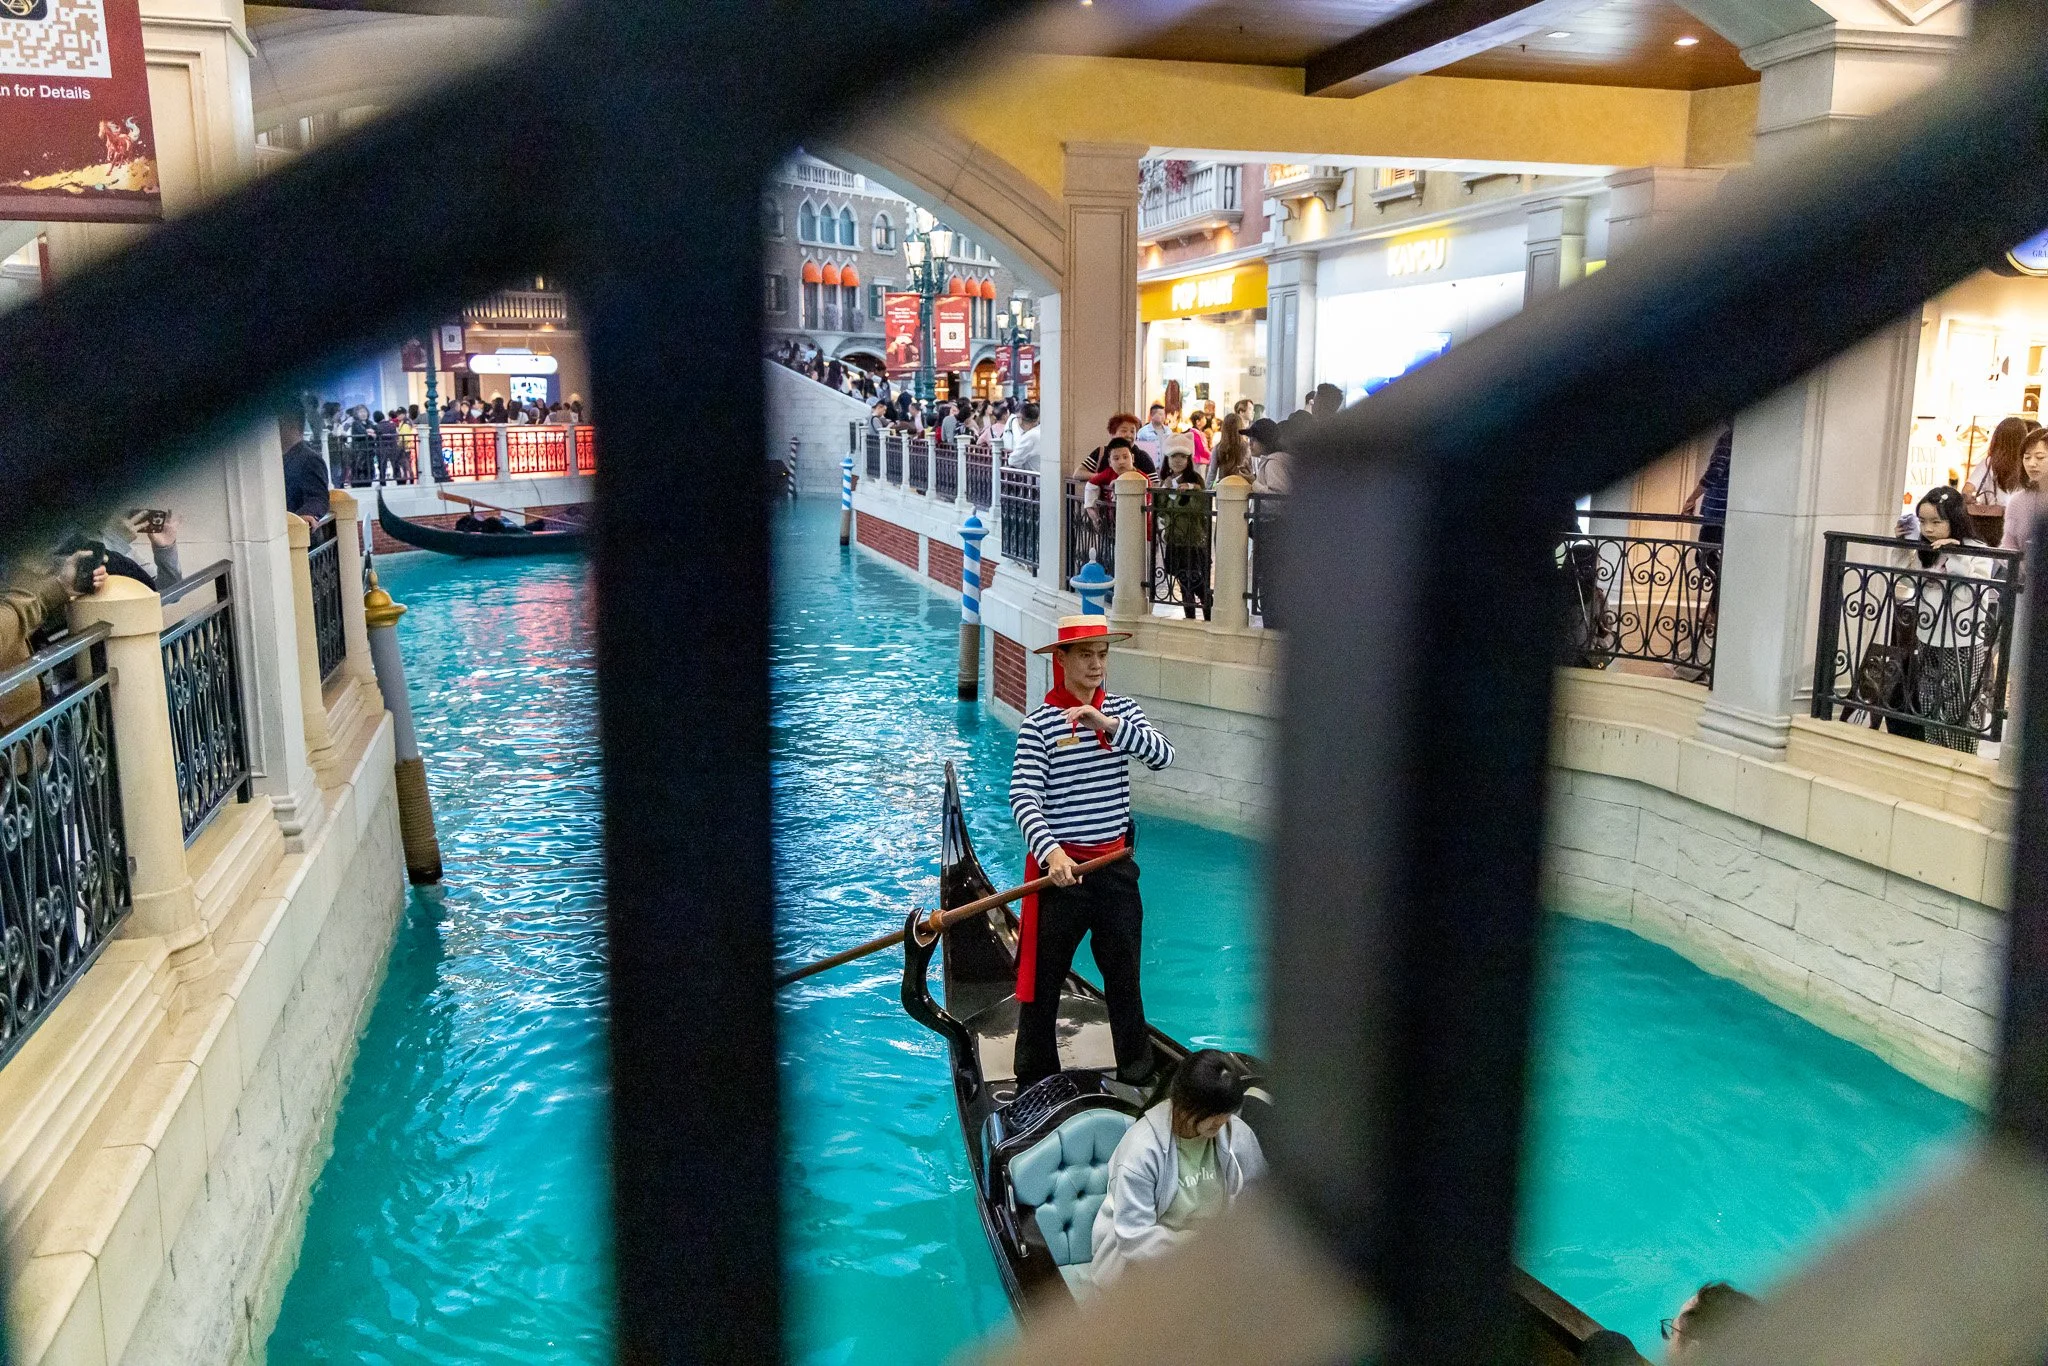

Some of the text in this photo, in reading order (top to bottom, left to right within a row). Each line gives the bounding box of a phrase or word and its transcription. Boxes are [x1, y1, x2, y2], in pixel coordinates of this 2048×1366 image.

[0, 84, 92, 99] n for Details
